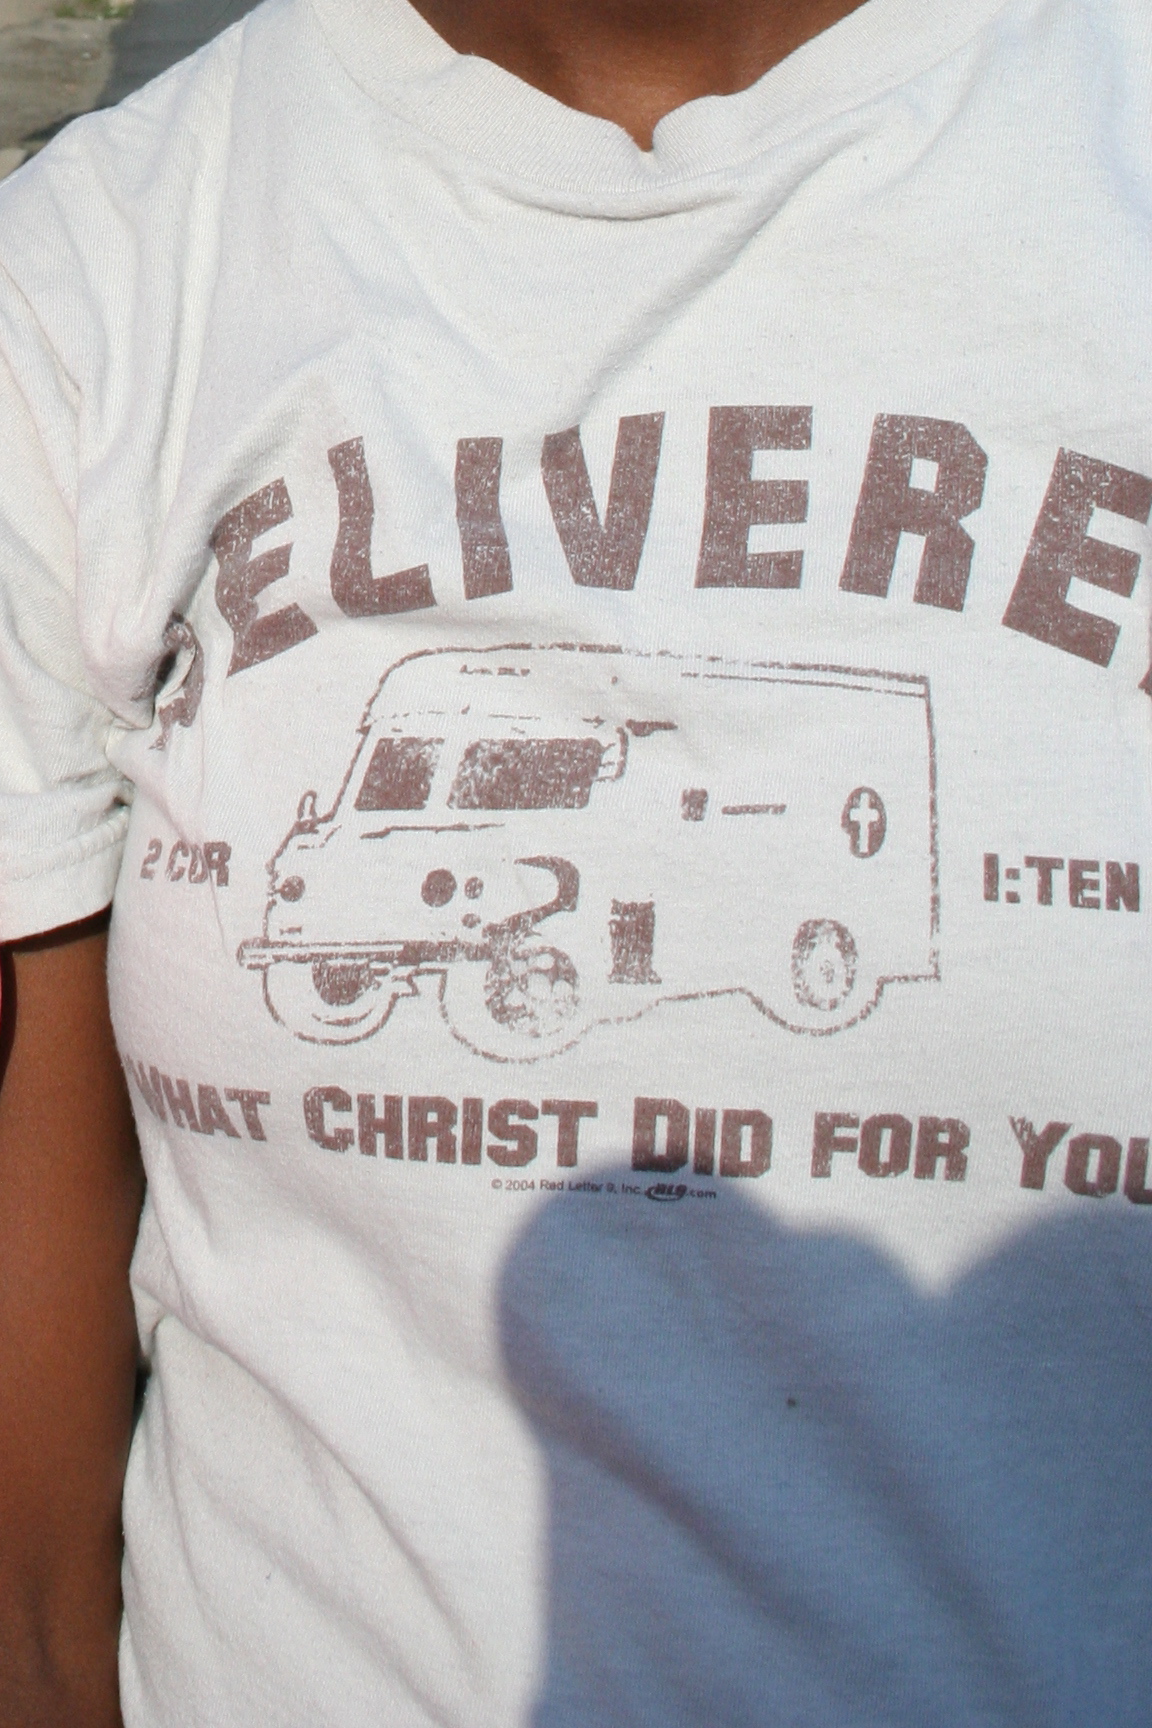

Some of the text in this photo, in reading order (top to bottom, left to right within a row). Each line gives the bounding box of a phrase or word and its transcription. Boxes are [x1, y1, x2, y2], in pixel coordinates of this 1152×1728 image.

[150, 405, 1152, 749] ELIVERE
[140, 838, 163, 880] 2
[165, 840, 232, 887] COR
[123, 1054, 271, 1142] WHAT
[303, 1085, 599, 1167] CHRIST
[631, 1096, 773, 1178] DID
[811, 1111, 970, 1182] FOR
[505, 1179, 535, 1190] 2004
[540, 1179, 564, 1190] Red
[568, 1180, 603, 1192] Letter
